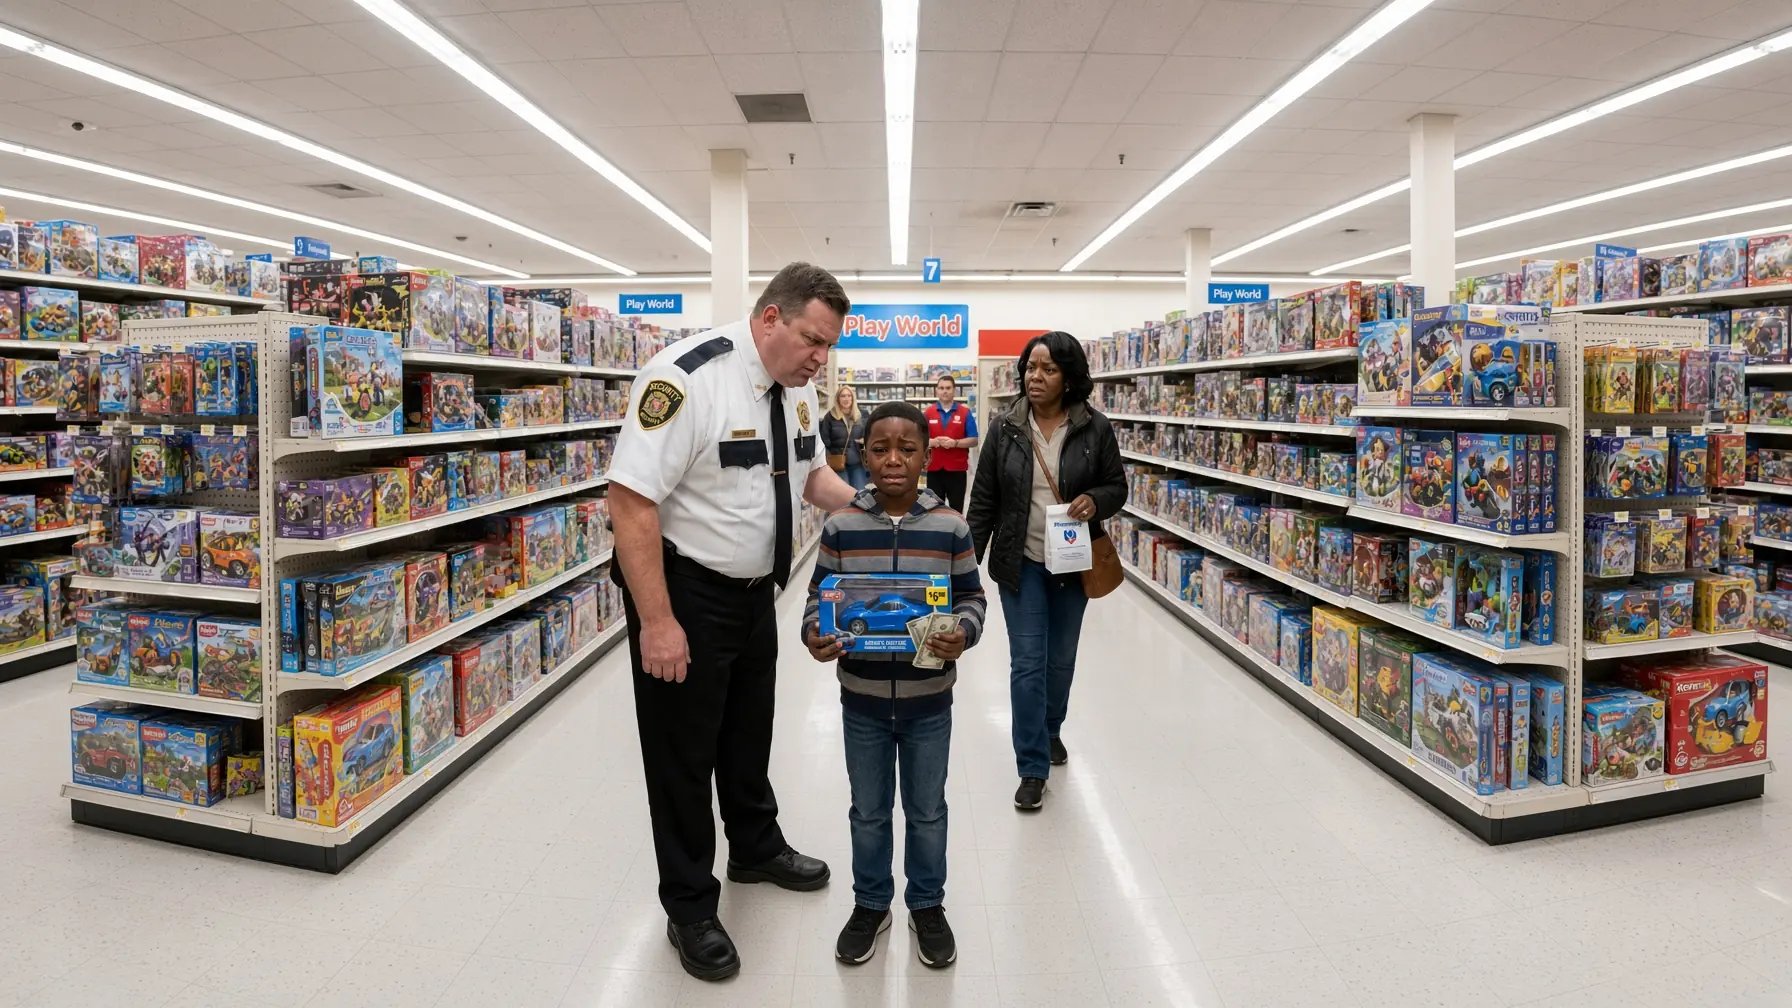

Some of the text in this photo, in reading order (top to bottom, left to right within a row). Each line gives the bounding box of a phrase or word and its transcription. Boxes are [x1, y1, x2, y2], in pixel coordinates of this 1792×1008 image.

[926, 261, 938, 280] 7
[1213, 288, 1261, 301] Play World
[626, 299, 674, 312] Play World
[843, 314, 961, 341] Play World
